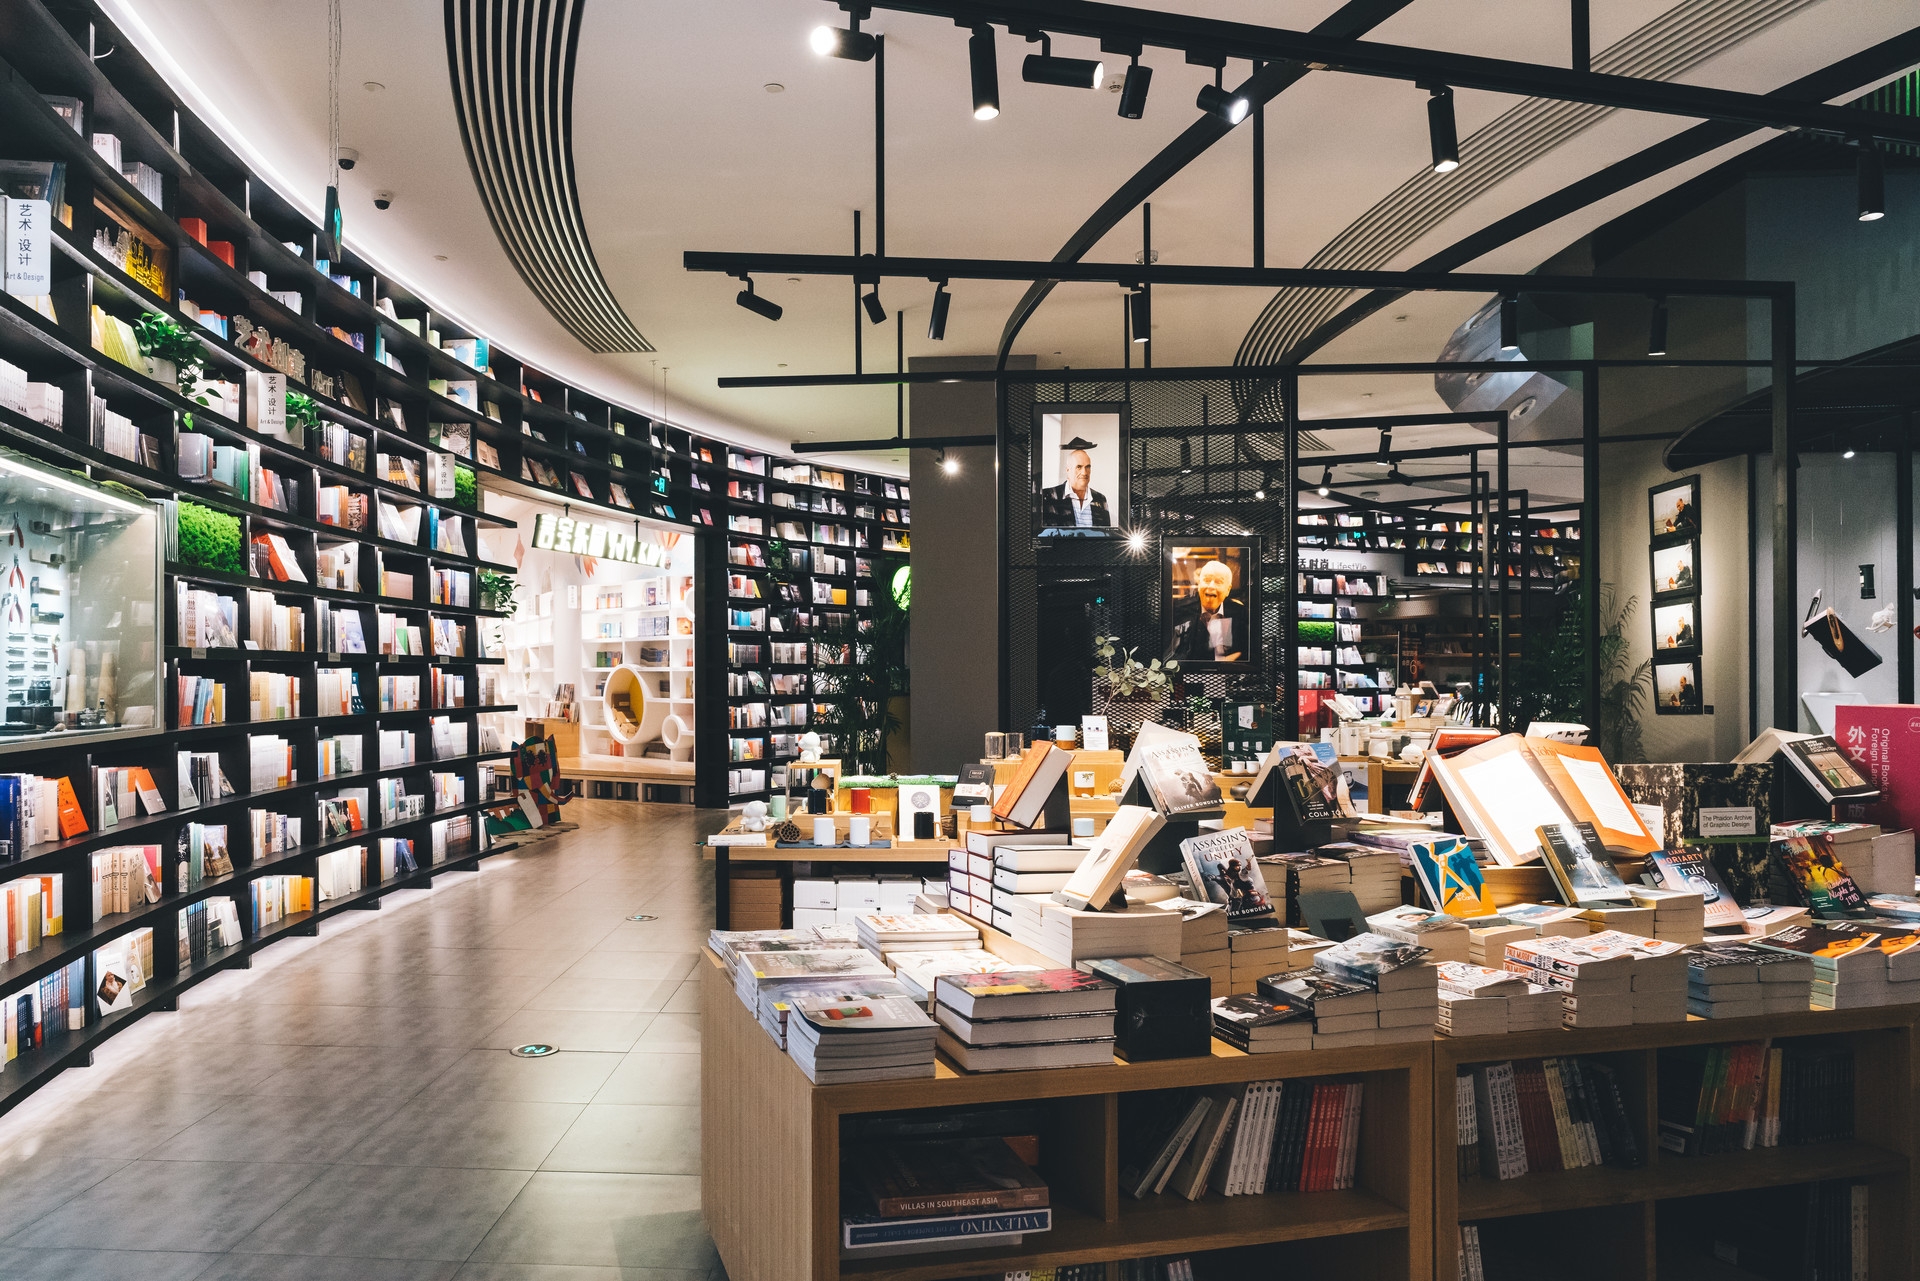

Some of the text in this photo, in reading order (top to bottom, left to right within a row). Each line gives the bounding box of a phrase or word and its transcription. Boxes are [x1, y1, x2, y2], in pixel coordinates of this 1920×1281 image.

[5, 272, 44, 282] Art & Design
[1870, 727, 1880, 762] Foreign
[1880, 728, 1890, 763] Original
[1881, 763, 1890, 793] Books
[1173, 799, 1218, 811] OLIVER BOWDEN
[1731, 821, 1751, 829] Design
[1203, 846, 1243, 862] UNITY
[1208, 843, 1235, 853] CREED
[1667, 848, 1687, 856] LIANE
[1658, 853, 1703, 865] MORIARTY
[1671, 863, 1706, 877] Truly
[1845, 892, 1860, 905] 1980
[1242, 905, 1267, 915] BOWDEN
[1704, 901, 1732, 915] uilty
[1506, 946, 1533, 963] PAUL MURRAY
[900, 1202, 926, 1211] VILLAS
[937, 1198, 980, 1208] SOUTHEAST
[981, 1197, 998, 1205] ASIA
[960, 1215, 1040, 1233] VALENTINO
